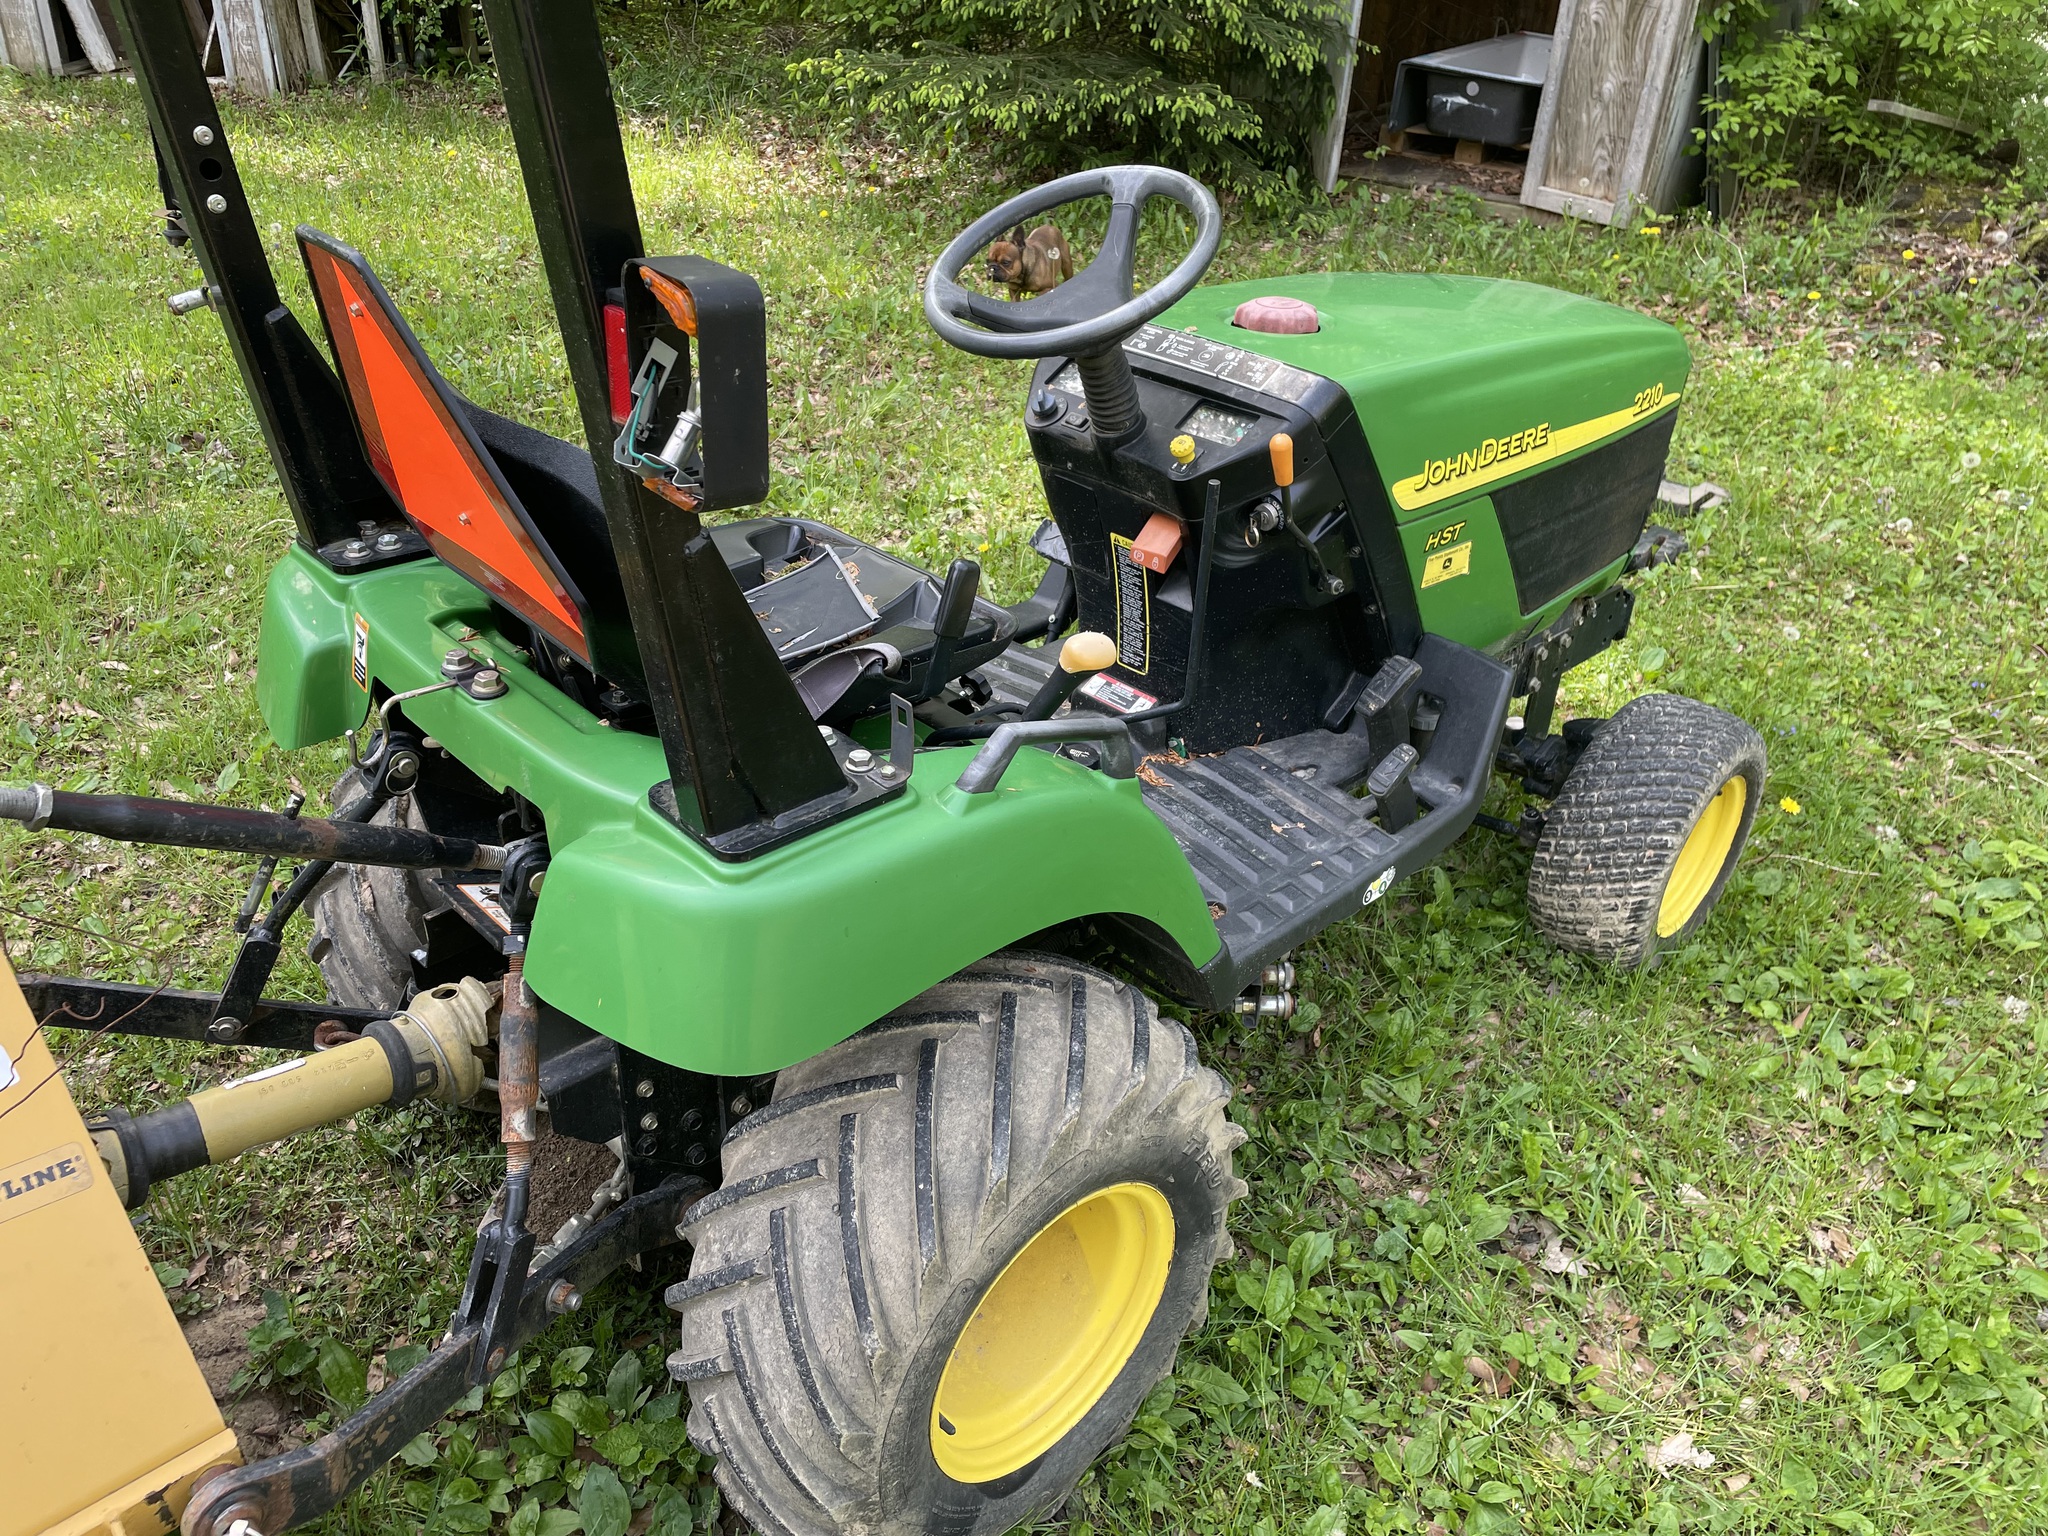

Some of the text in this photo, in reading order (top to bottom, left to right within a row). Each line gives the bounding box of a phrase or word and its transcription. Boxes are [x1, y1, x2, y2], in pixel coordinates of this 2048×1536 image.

[1633, 382, 1664, 417] 2210
[1413, 421, 1551, 491] JOHN DEERE
[1423, 520, 1467, 553] HST
[0, 1157, 77, 1200] LINE
